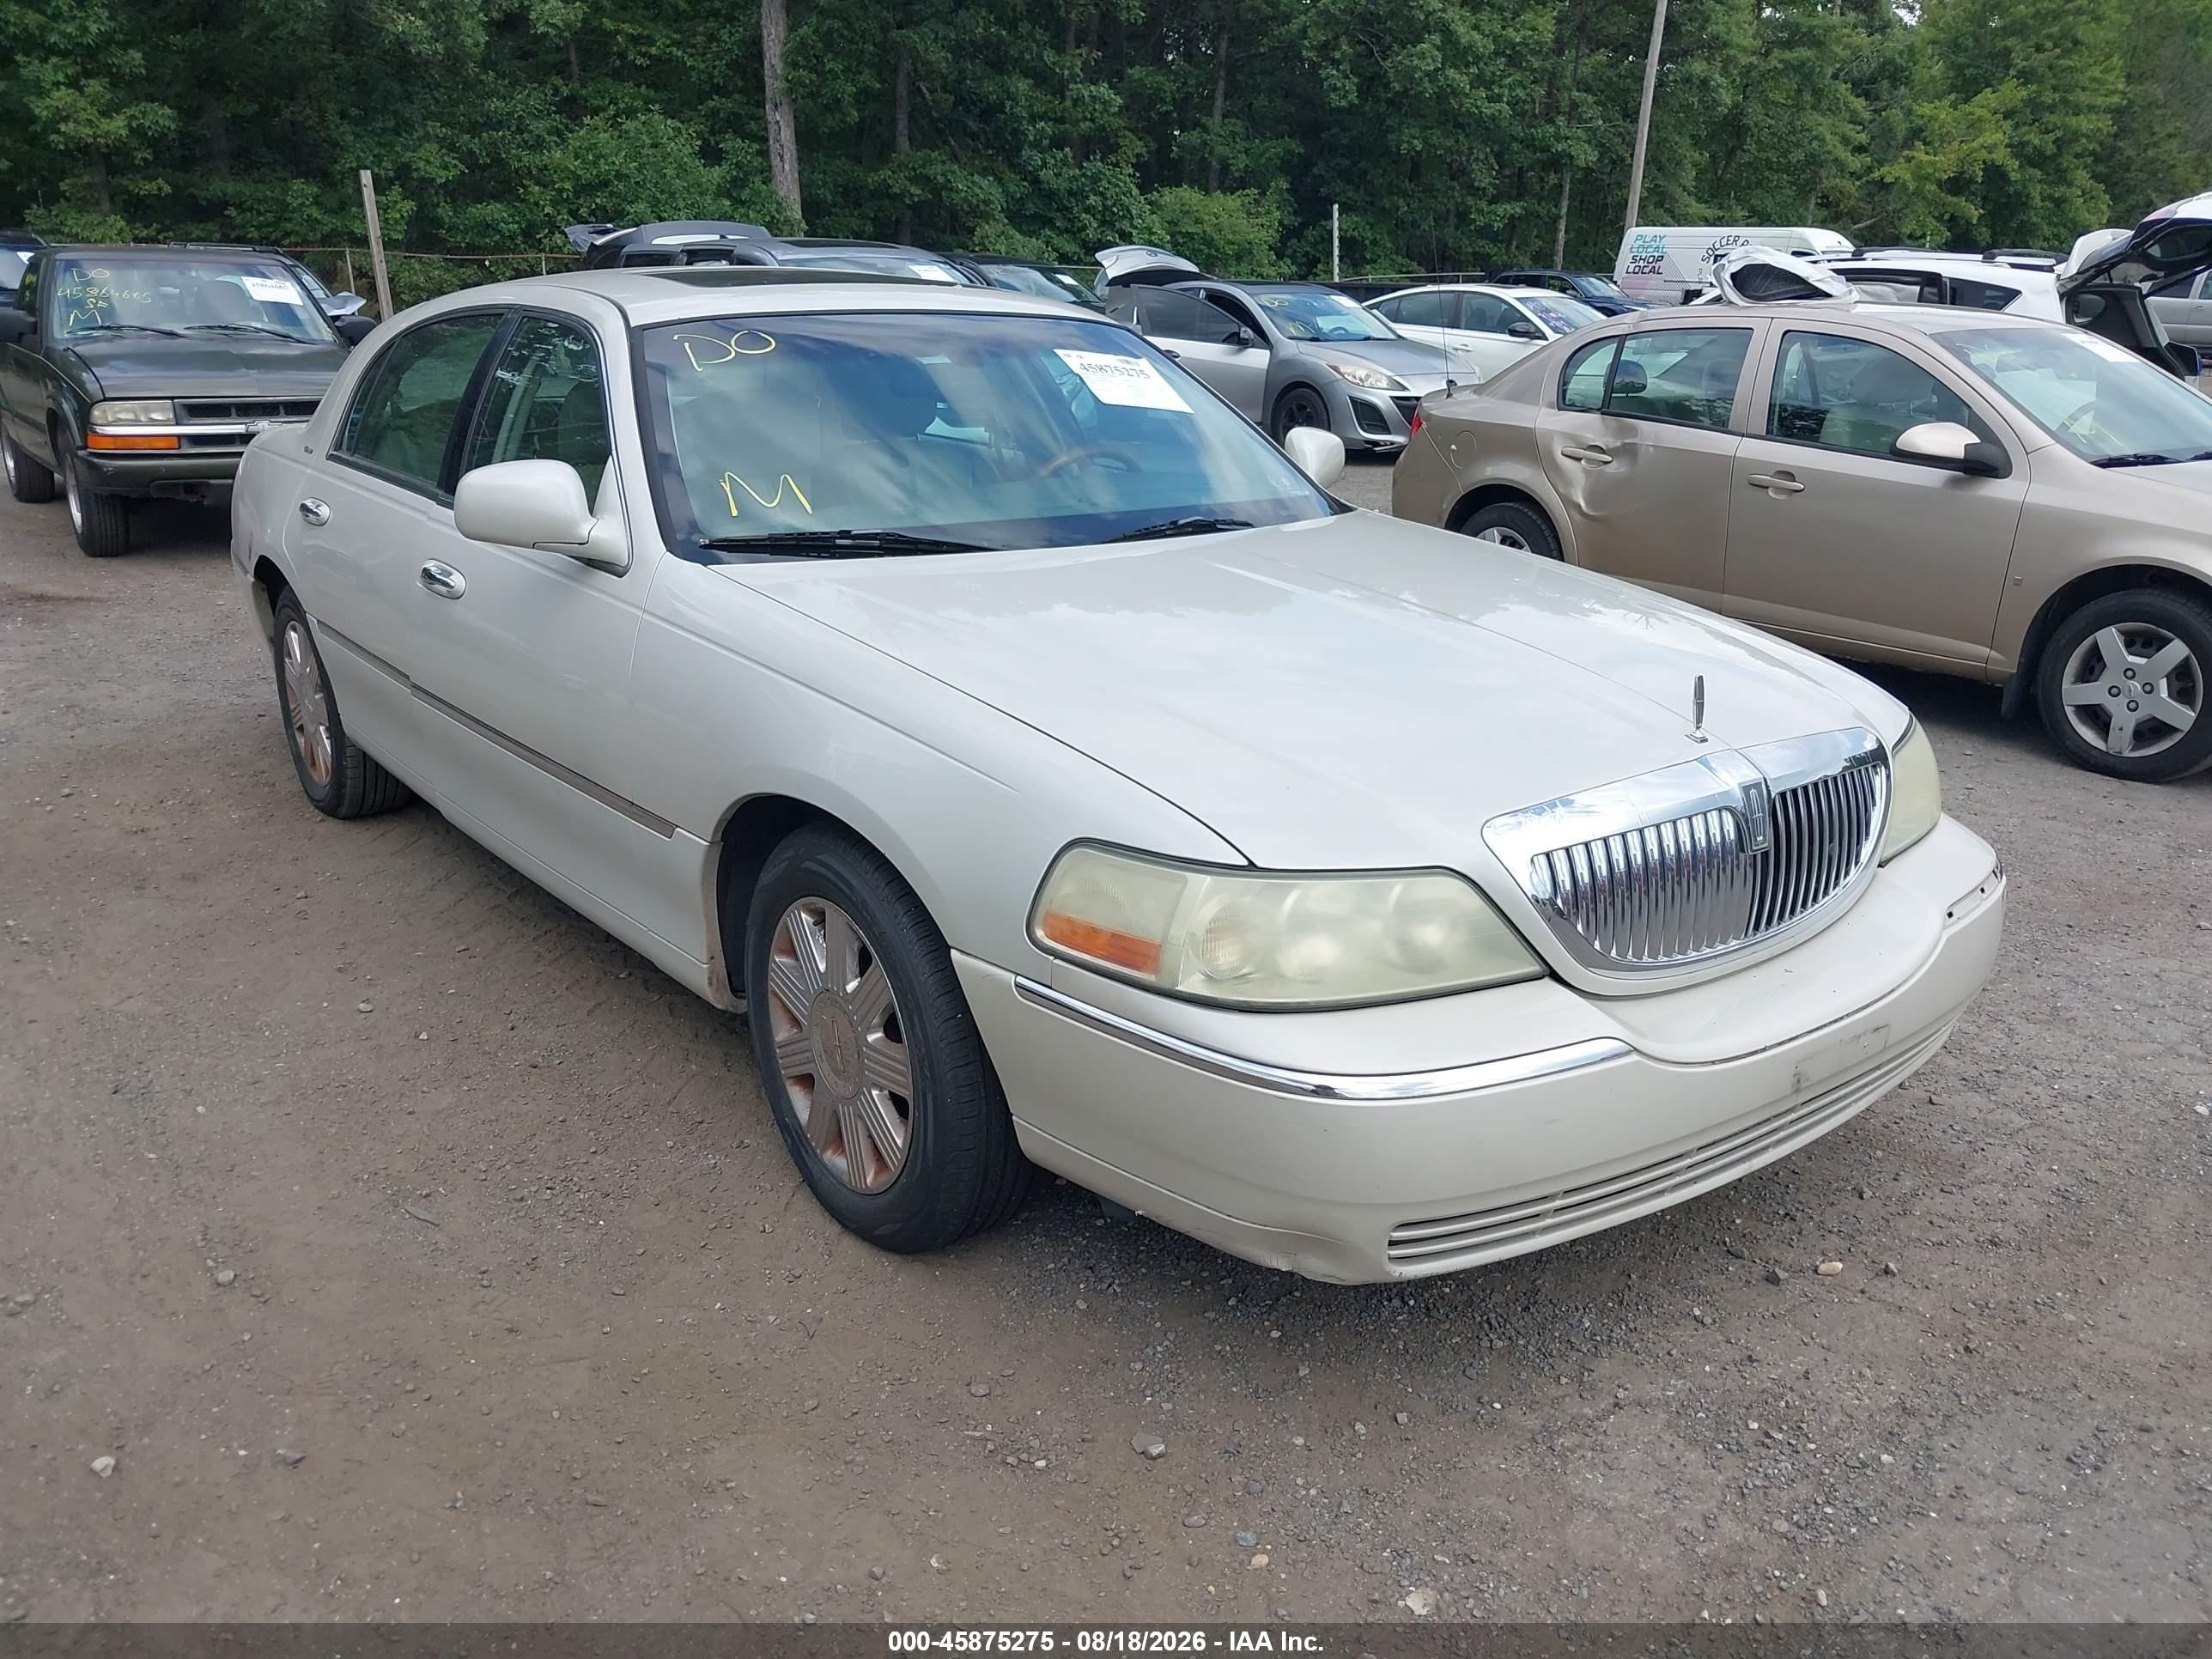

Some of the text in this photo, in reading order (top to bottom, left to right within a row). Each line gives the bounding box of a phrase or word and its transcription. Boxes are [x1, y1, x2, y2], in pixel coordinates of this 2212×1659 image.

[1634, 234, 1667, 244] PLAY
[1630, 244, 1667, 254] LOCAL
[1701, 234, 1741, 264] SOCCER
[1630, 254, 1664, 264] SHOP
[71, 268, 110, 283] DO
[1626, 264, 1663, 275] LOCAL
[69, 309, 102, 327] M
[673, 330, 776, 371] DO
[1079, 362, 1152, 380] 45875275
[719, 471, 813, 517] M
